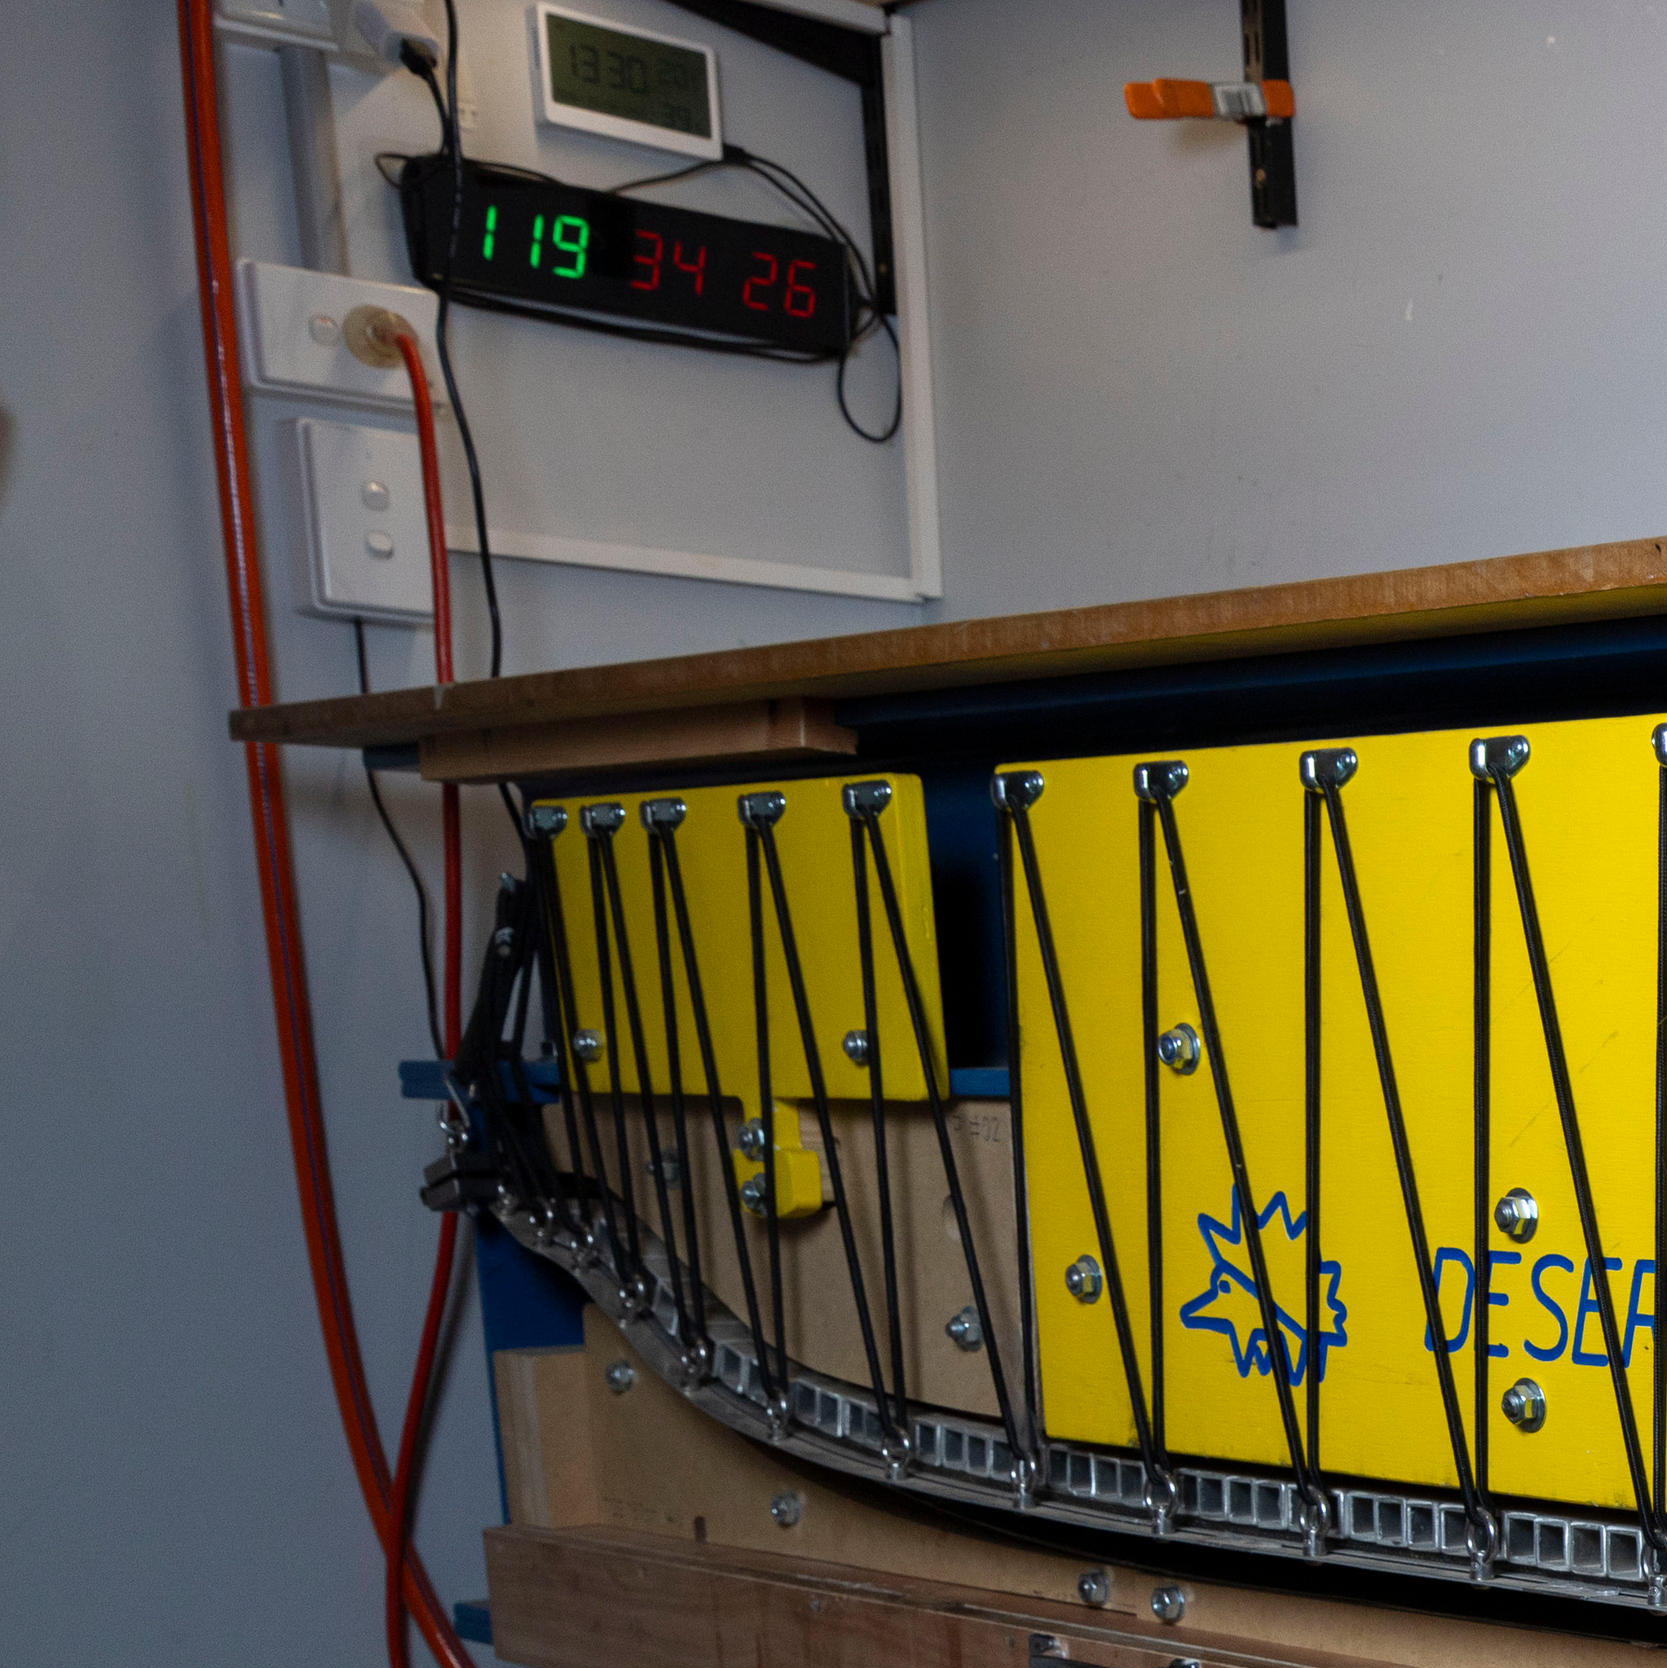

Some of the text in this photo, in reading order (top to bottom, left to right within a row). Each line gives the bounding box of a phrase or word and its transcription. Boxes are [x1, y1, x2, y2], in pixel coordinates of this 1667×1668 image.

[483, 205, 816, 318] 119 34 26
